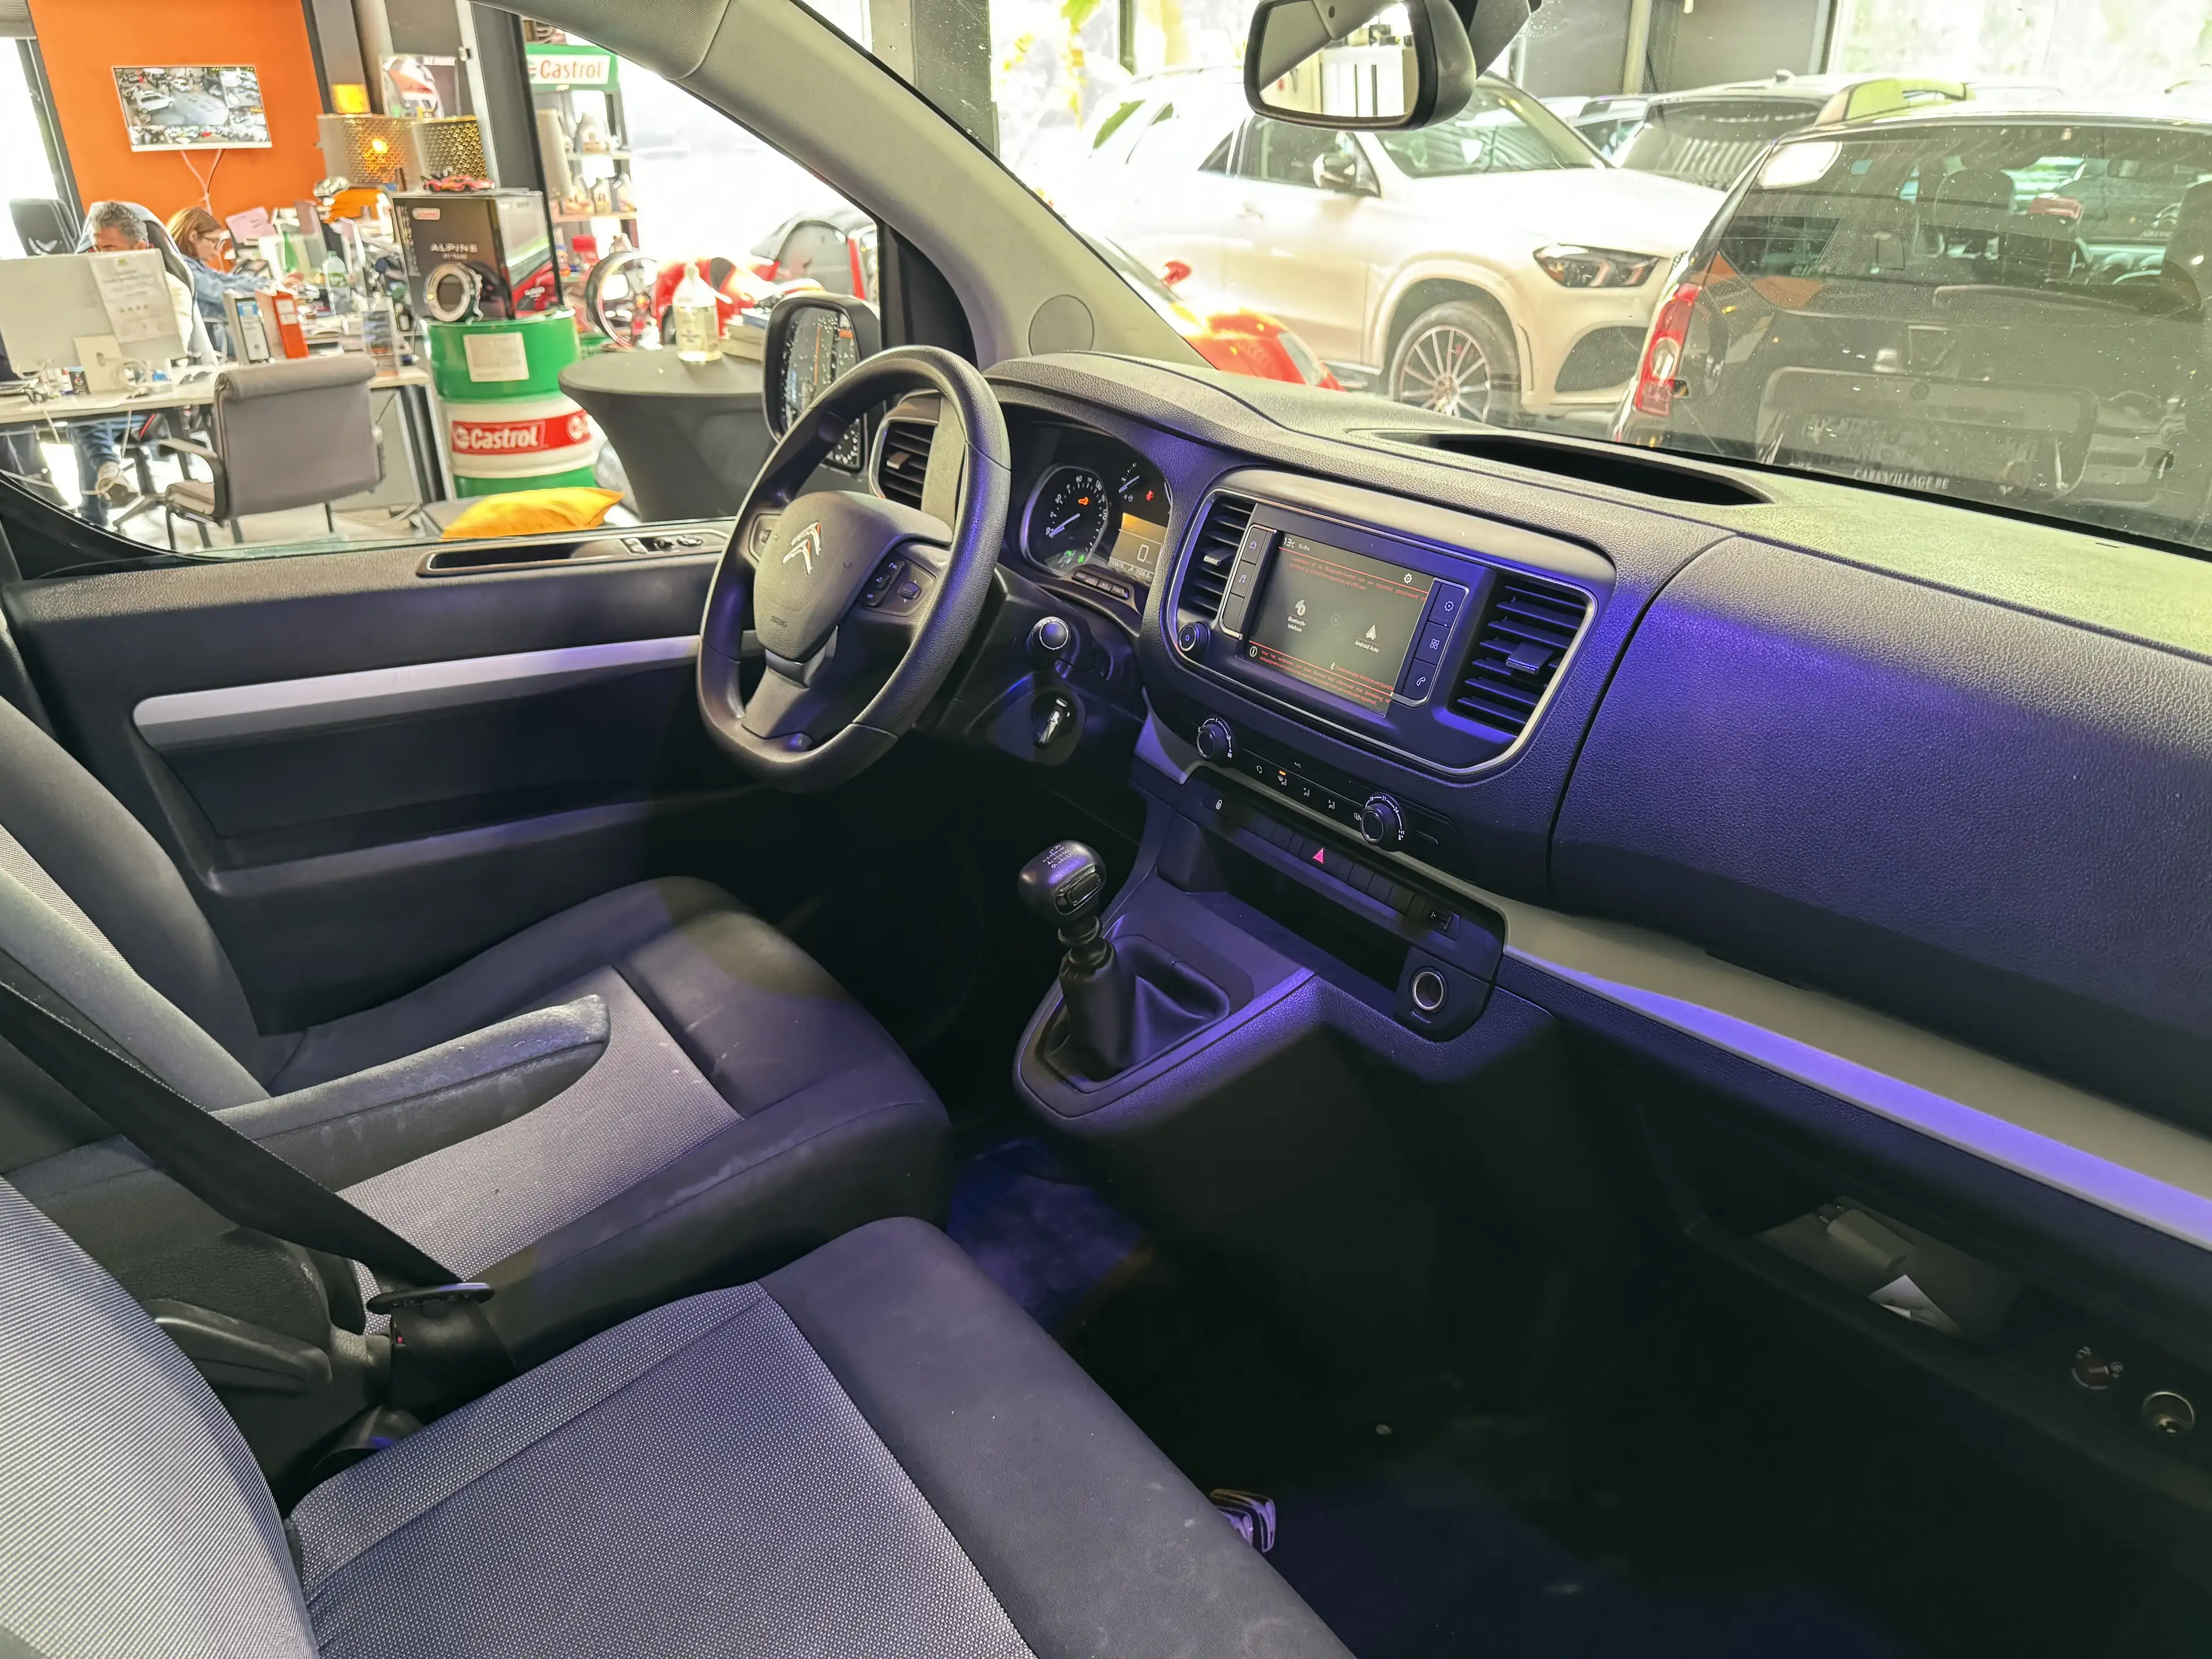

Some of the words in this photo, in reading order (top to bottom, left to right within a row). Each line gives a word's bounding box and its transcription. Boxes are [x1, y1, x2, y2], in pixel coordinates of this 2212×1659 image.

[540, 60, 601, 78] Castrol
[430, 243, 478, 252] ALPINE
[469, 425, 539, 449] Castrol
[1137, 544, 1149, 562] 0
[1354, 640, 1370, 650] Android
[1369, 645, 1379, 653] Auto
